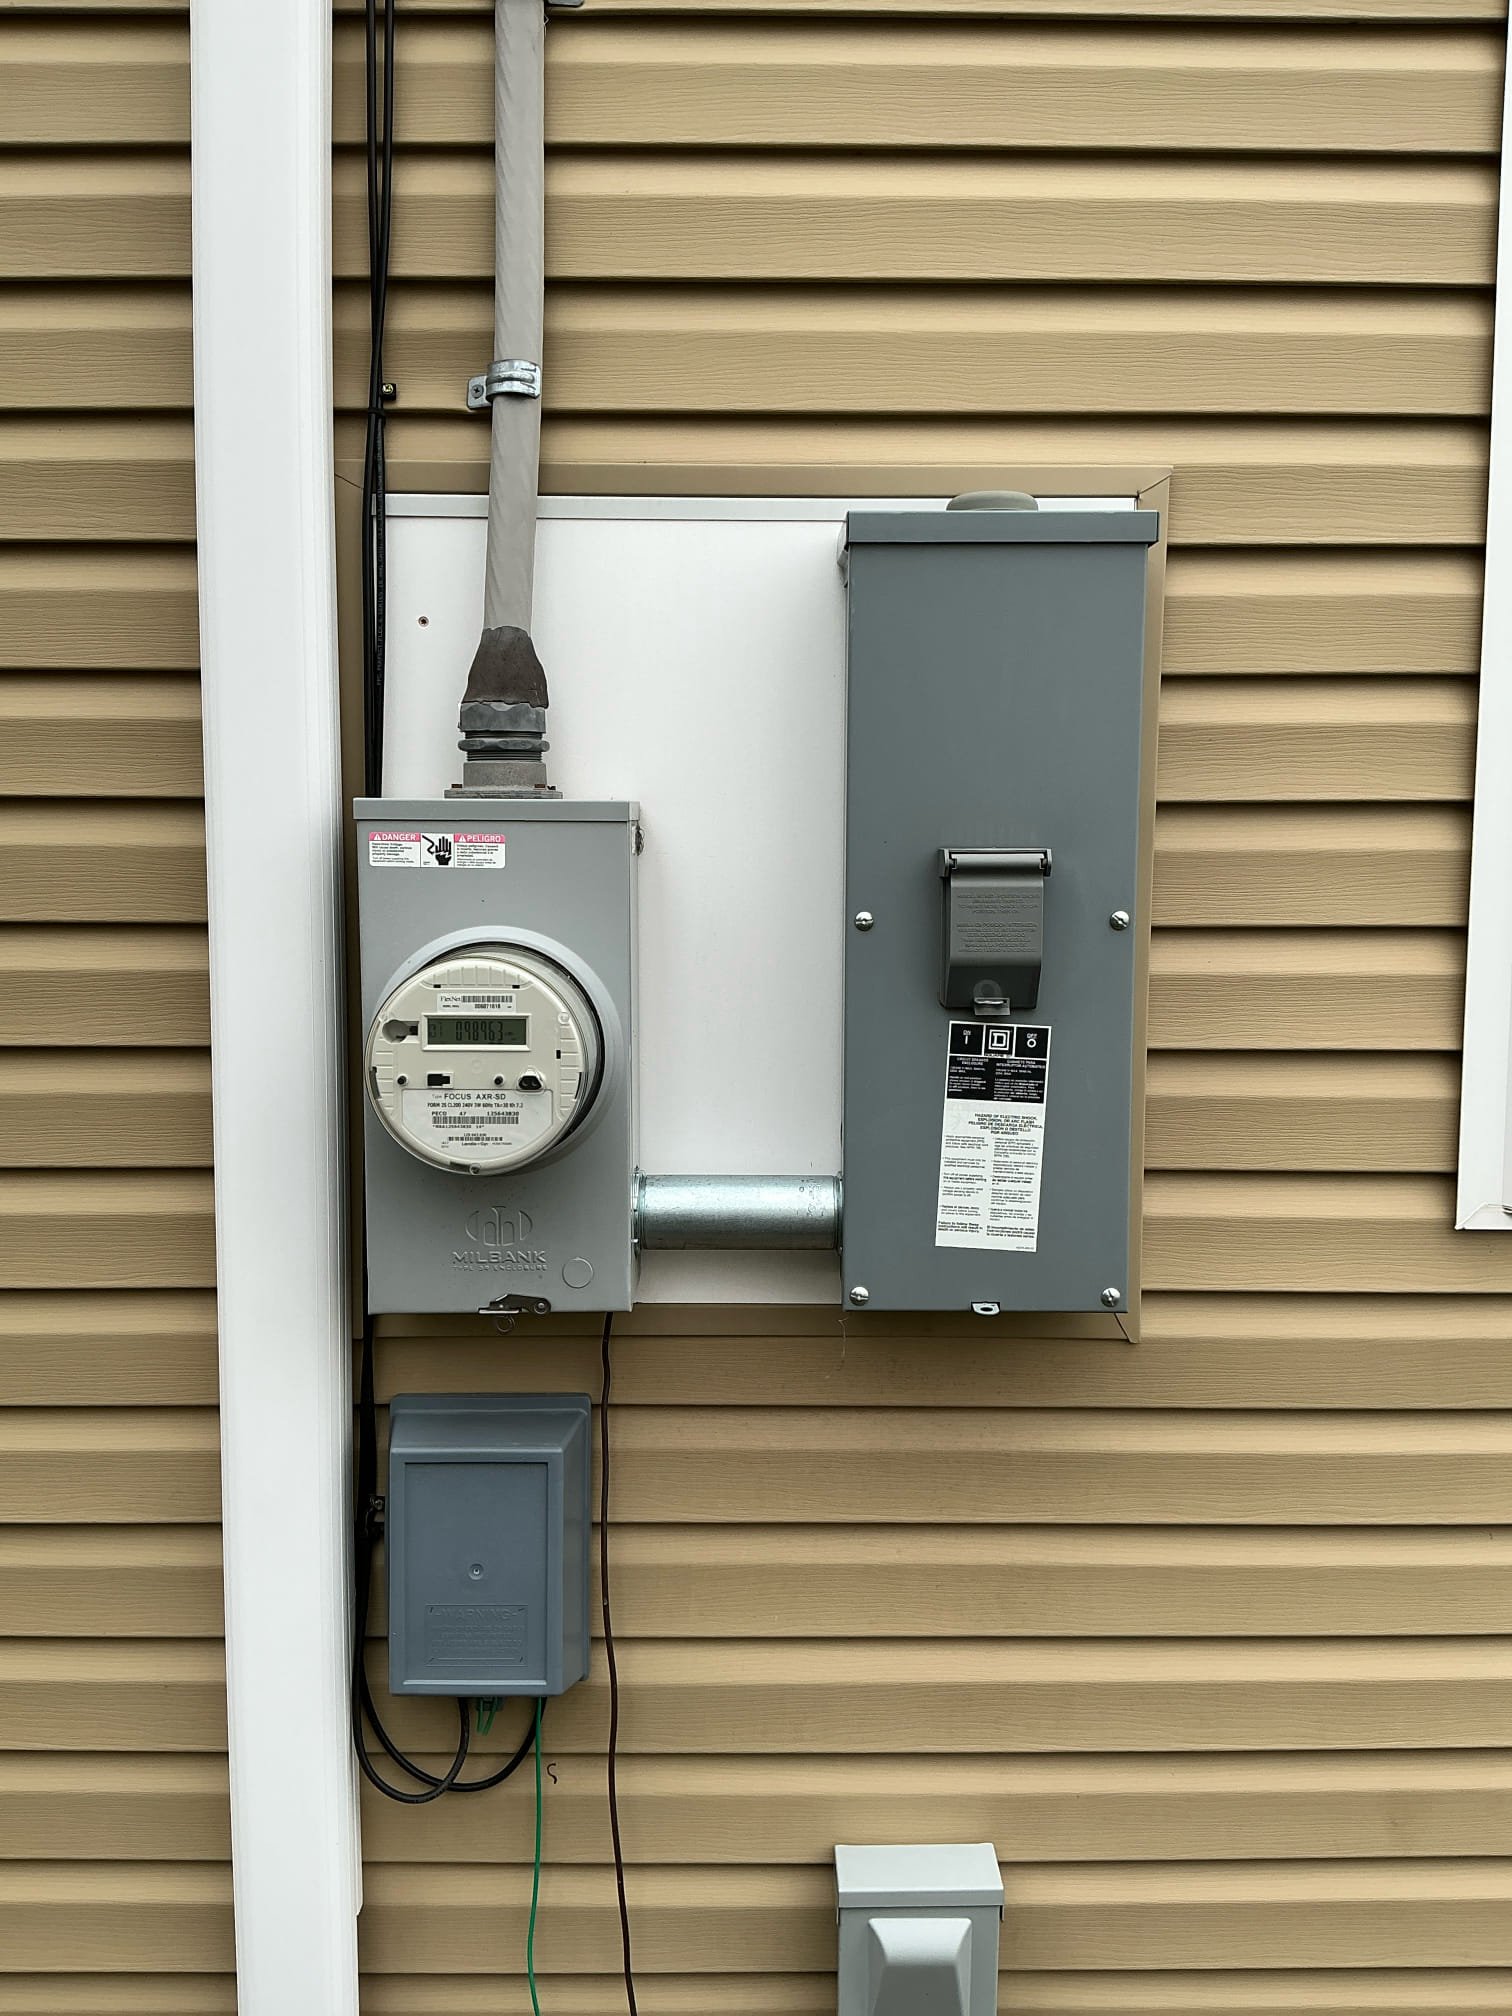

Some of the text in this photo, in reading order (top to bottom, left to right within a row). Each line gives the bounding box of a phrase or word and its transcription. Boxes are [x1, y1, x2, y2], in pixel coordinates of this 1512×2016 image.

[467, 834, 500, 842] PELIGRO
[992, 1032, 1006, 1047] D
[452, 1250, 547, 1264] MILBANK
